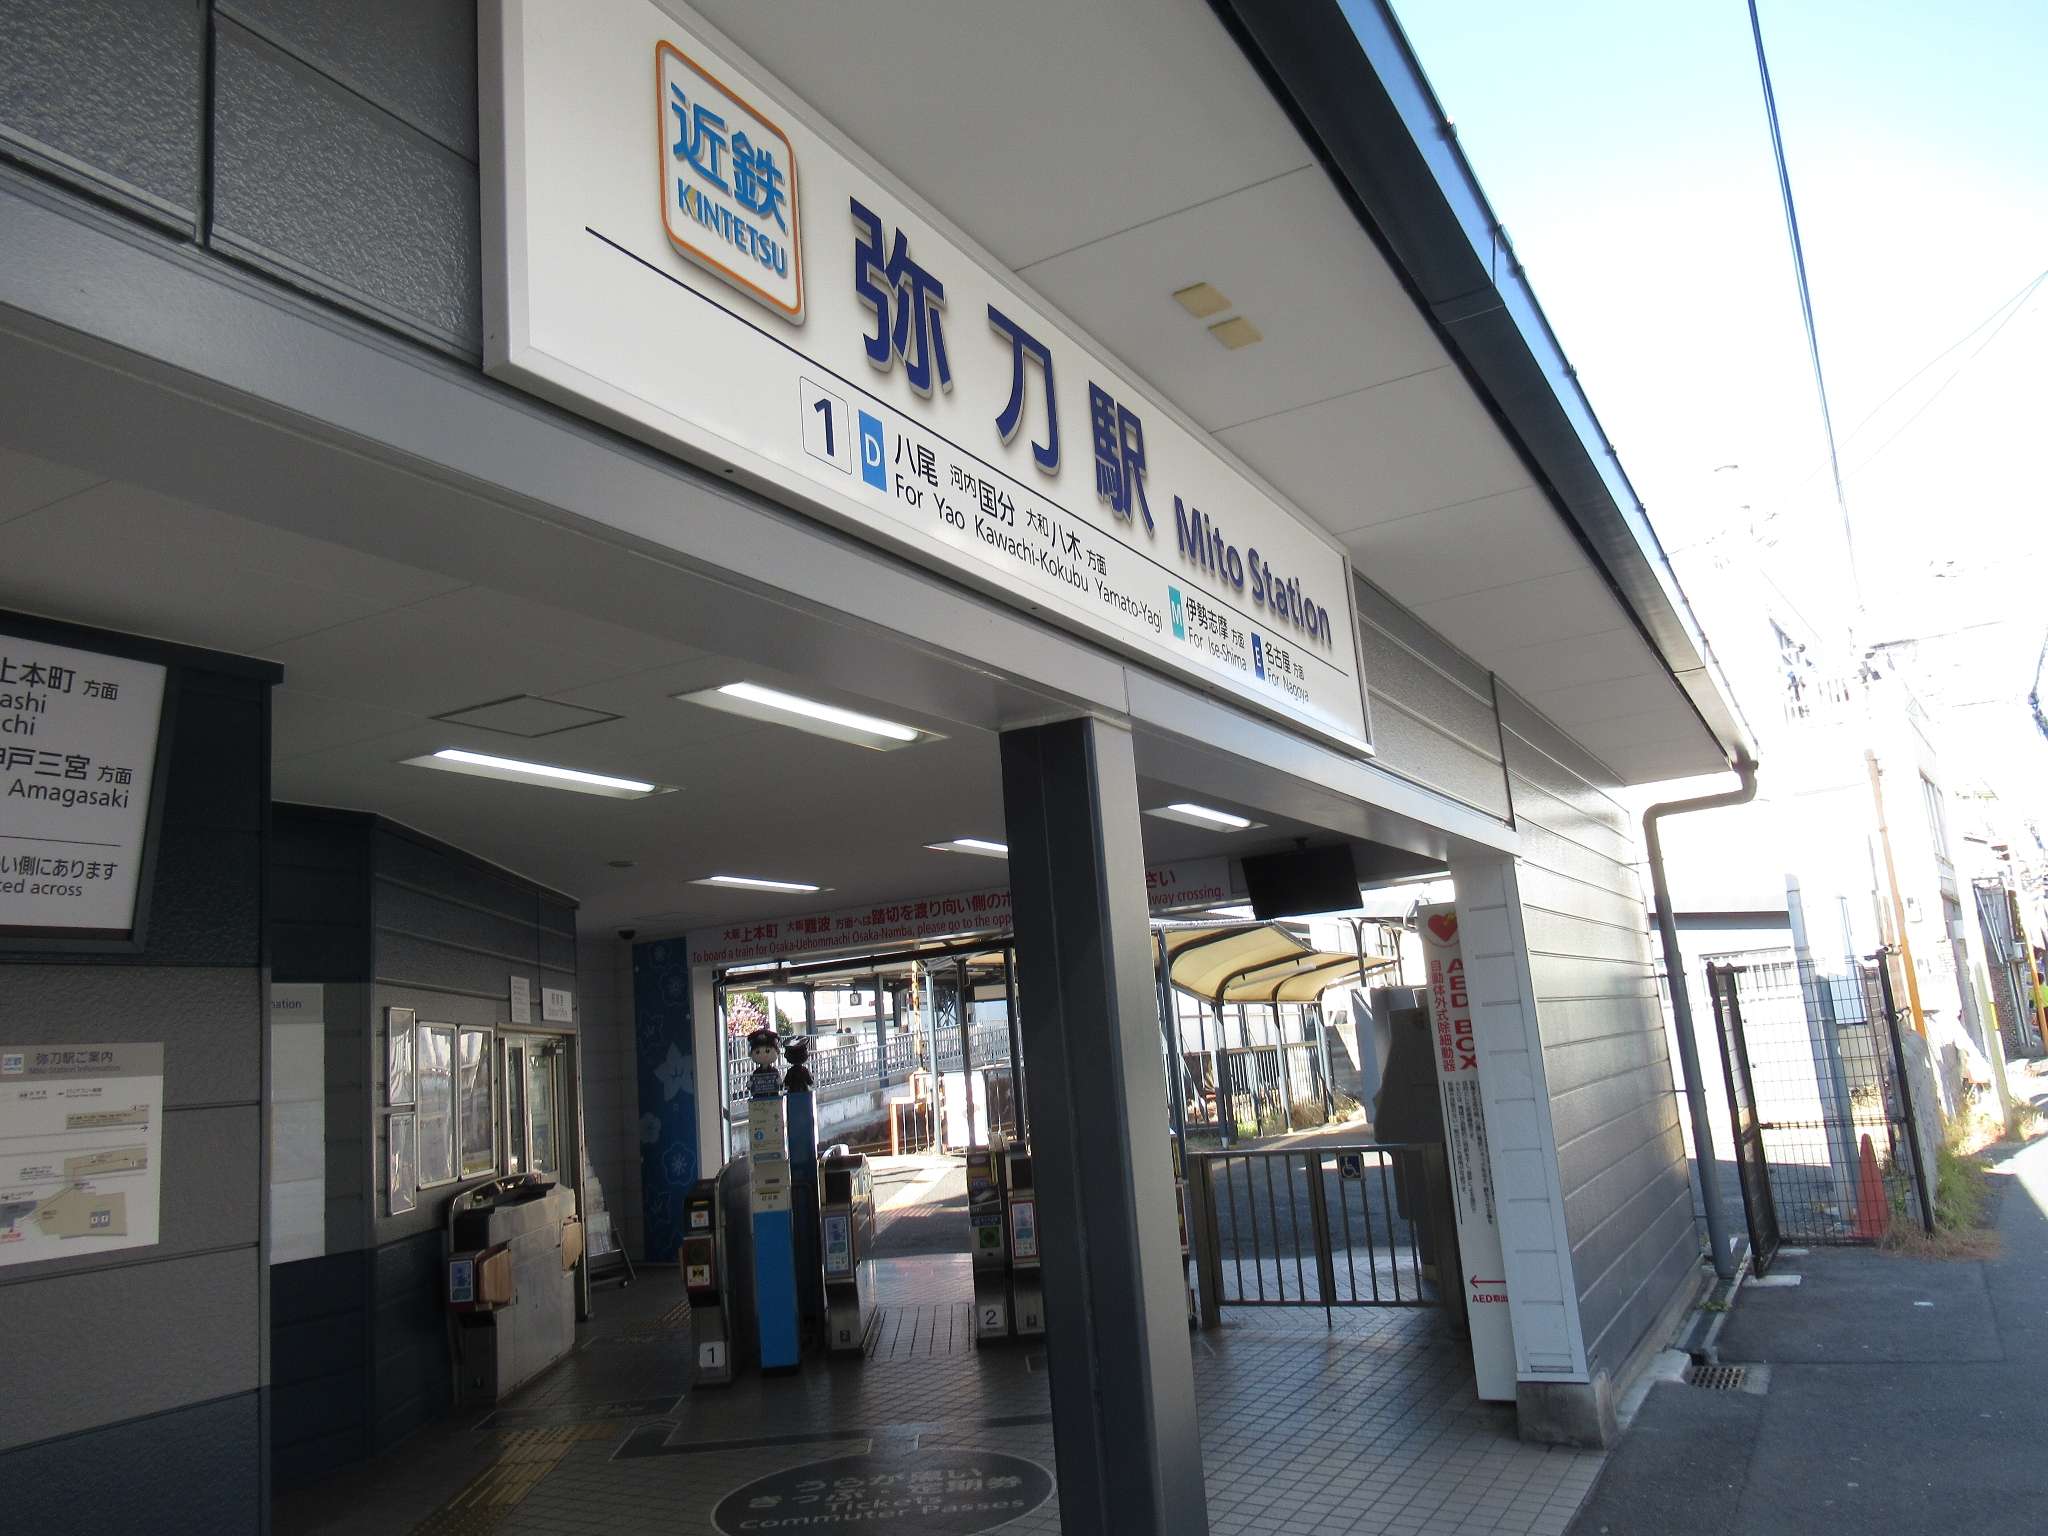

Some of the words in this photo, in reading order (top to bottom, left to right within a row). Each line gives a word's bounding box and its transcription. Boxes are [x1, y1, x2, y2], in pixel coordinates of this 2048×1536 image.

[671, 83, 787, 233] 近鉄
[677, 177, 788, 278] KINTETSU
[850, 196, 1155, 535] 弥刀駅
[813, 398, 835, 457] 1
[864, 433, 881, 467] D
[894, 433, 938, 488] 八尾
[949, 463, 1016, 527] 河内国分
[1025, 508, 1083, 561] 大和八木
[1086, 548, 1107, 576] 方面
[895, 473, 924, 508] For
[934, 492, 965, 530] Yao
[975, 513, 1089, 593] Kawachi-Kokubu
[1095, 577, 1163, 633] Yamato-Yagi
[1173, 494, 1244, 592] Mito
[1248, 546, 1333, 648] Station
[1170, 599, 1183, 625] M
[1185, 596, 1228, 640] 伊勢志摩
[1231, 628, 1245, 649] 方面
[1188, 626, 1203, 651] For
[1208, 637, 1247, 672] Ise-Shima
[1255, 645, 1262, 667] E
[1265, 641, 1291, 674] 名古屋
[1293, 662, 1305, 681] 方面
[0, 656, 77, 694] 上本町
[82, 680, 119, 701] 方面
[1267, 667, 1280, 687] For
[1283, 676, 1309, 704] Nagoya
[2, 714, 36, 736] chi
[97, 765, 133, 785] 方面
[8, 778, 129, 809] Amagasaki
[1, 855, 119, 881] い側にあります
[30, 883, 83, 897] across
[1177, 885, 1224, 902] crossing.
[723, 923, 779, 943] 大阪上本町
[735, 946, 754, 959] train
[756, 943, 768, 956] for
[917, 918, 946, 936] please
[947, 919, 961, 932] go
[963, 916, 973, 928] to
[974, 913, 991, 927] the
[985, 1310, 997, 1326] 2
[707, 1345, 716, 1364] 1
[738, 1509, 909, 1531] Commuter
[920, 1499, 1027, 1516] Passes
[826, 1495, 943, 1513] Tickets
